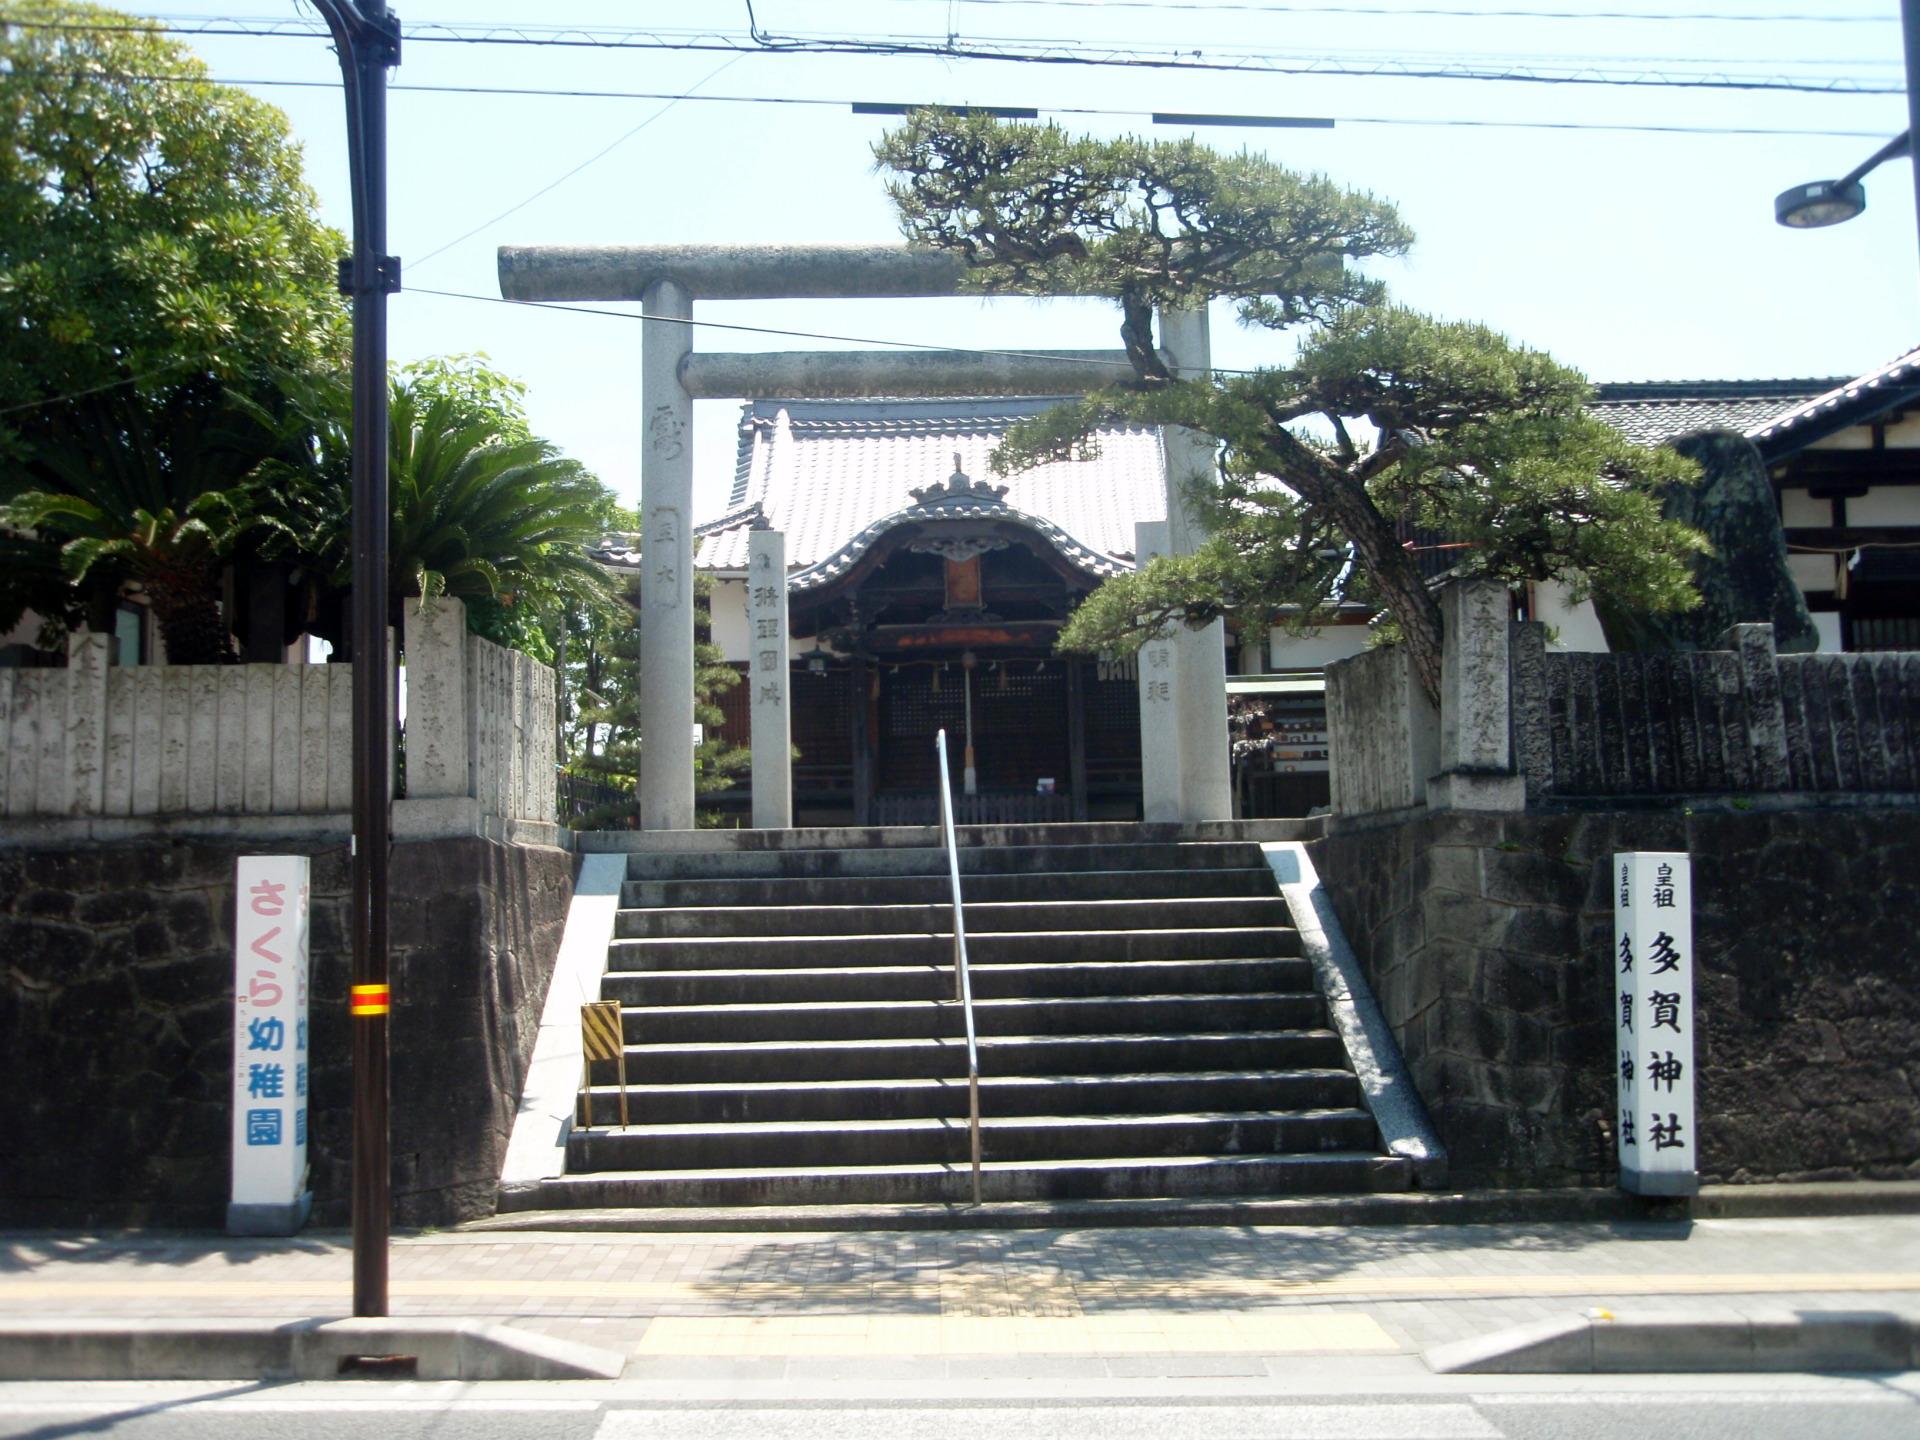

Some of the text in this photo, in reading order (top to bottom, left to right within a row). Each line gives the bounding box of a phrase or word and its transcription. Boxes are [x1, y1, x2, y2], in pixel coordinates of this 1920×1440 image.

[247, 880, 285, 1147] さくら幼稚園
[1647, 863, 1685, 1153] 皇祖 多賀神社
